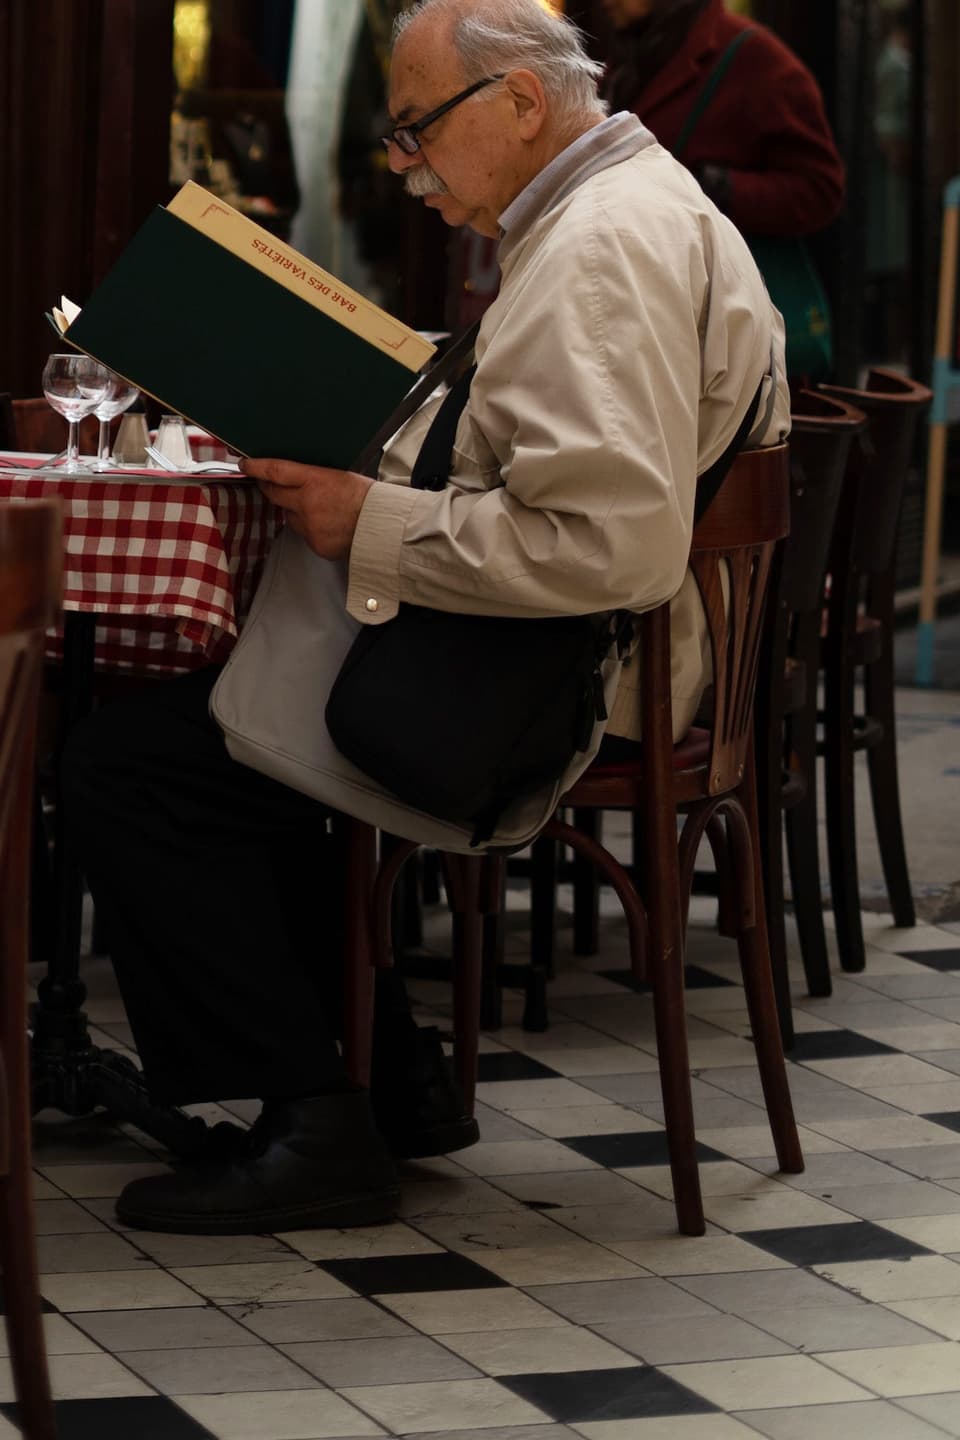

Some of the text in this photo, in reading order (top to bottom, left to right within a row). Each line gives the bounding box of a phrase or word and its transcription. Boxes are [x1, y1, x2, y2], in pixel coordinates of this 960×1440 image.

[250, 239, 358, 313] BAR DES VARIÉTÉS
